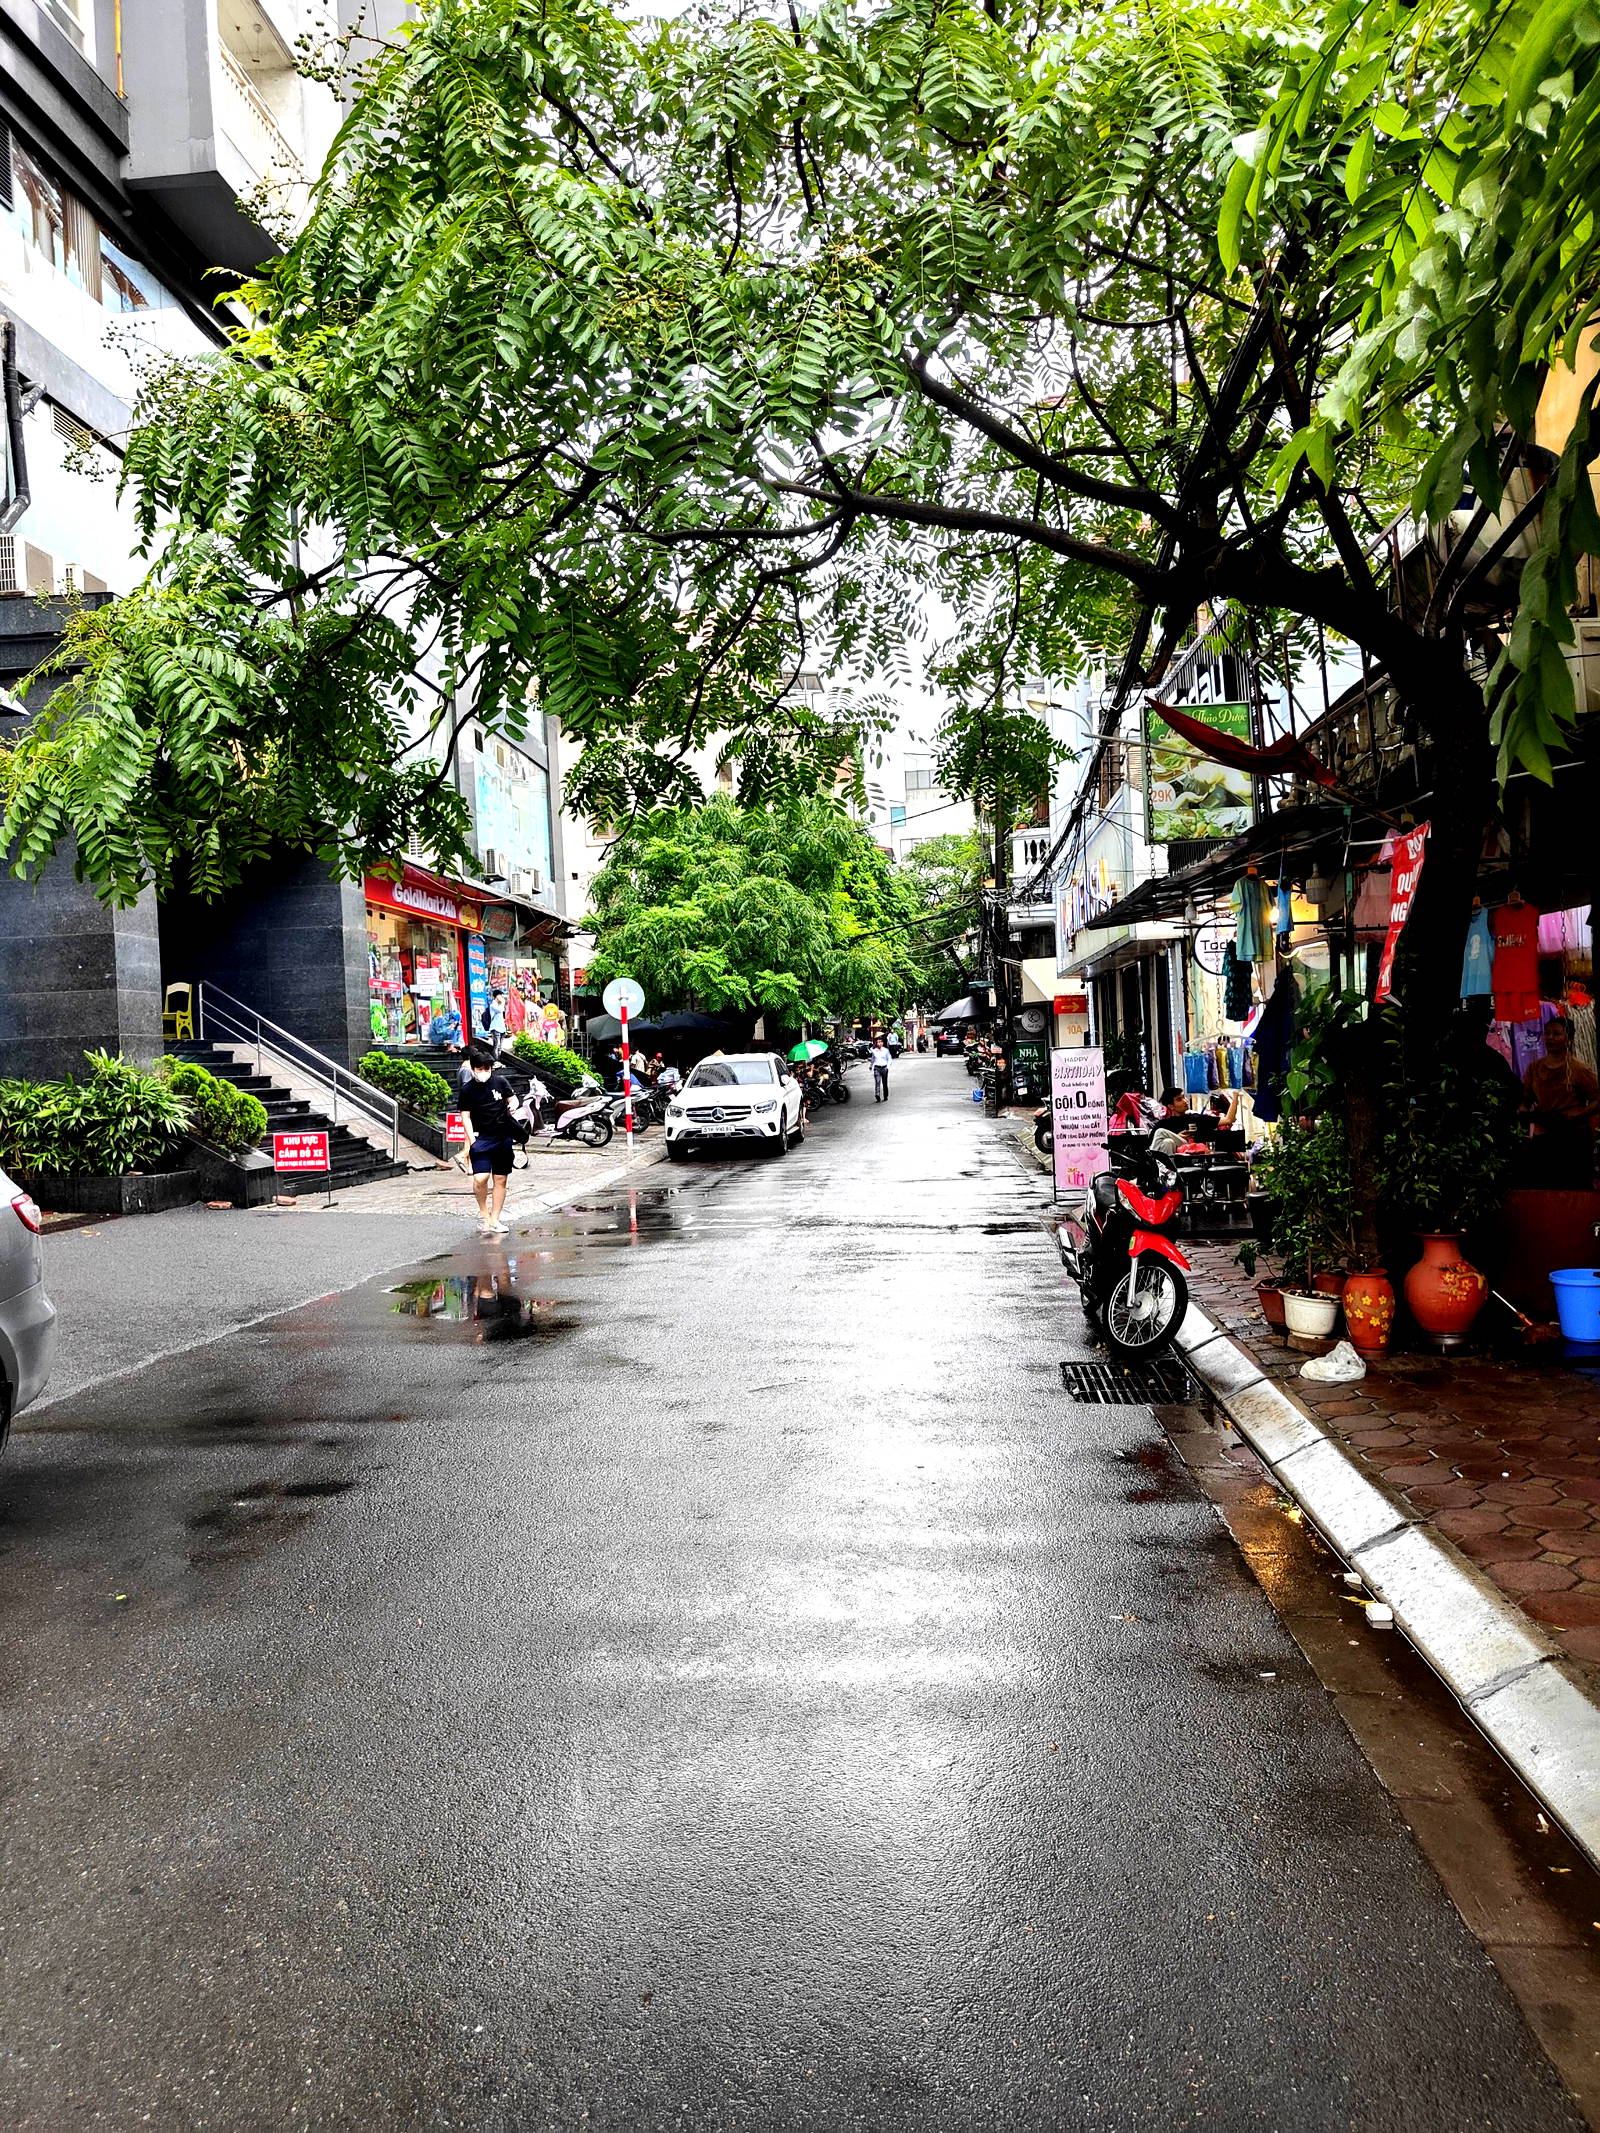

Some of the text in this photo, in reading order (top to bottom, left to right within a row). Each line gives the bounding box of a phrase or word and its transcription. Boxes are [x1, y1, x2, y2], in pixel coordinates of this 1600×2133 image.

[1067, 1024, 1083, 1035] 10A
[1064, 1055, 1089, 1063] HAPPY
[1054, 1064, 1102, 1080] BIRTHDAY
[283, 1136, 300, 1145] KHU
[313, 1148, 324, 1158] XE
